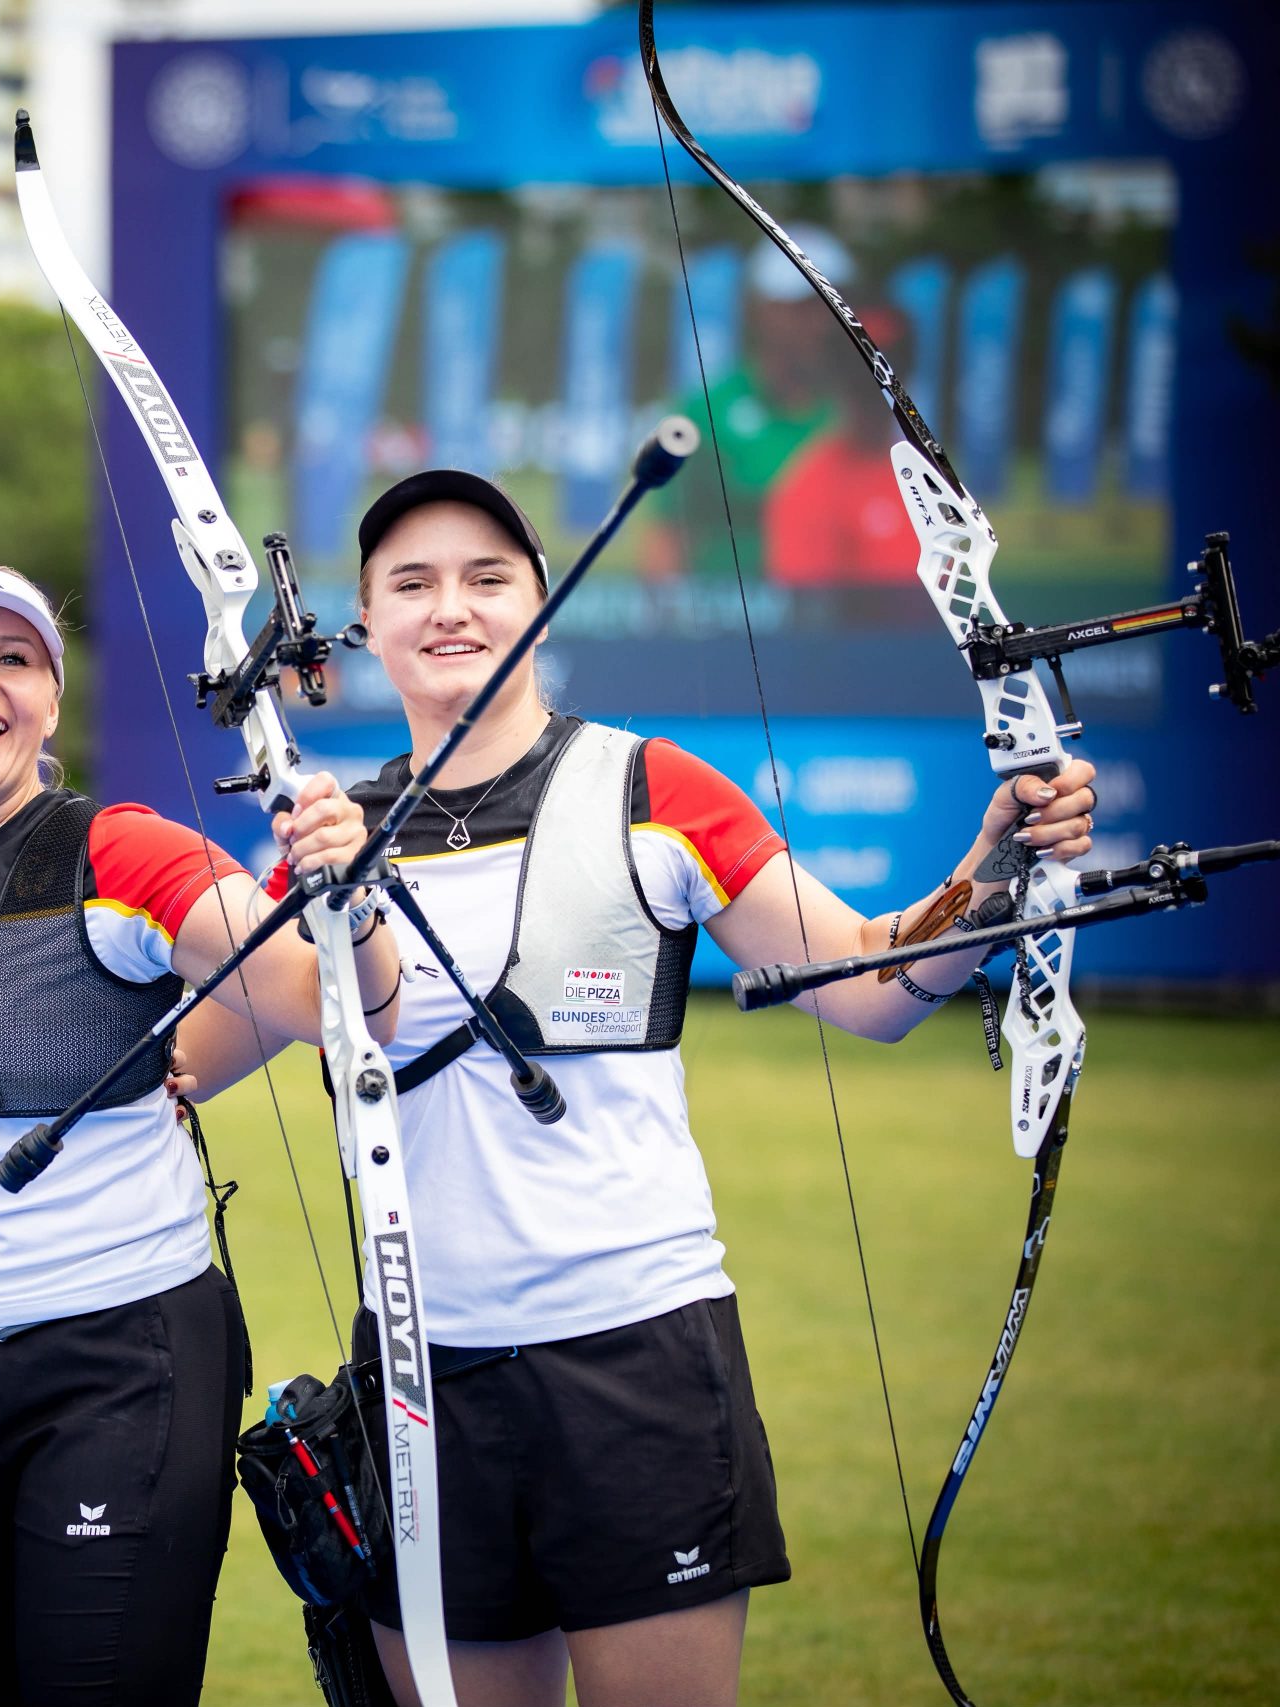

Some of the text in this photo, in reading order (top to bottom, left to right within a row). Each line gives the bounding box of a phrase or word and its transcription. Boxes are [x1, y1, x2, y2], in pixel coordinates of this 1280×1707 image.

[83, 295, 136, 352] METRIX
[123, 371, 191, 457] HOYT
[1068, 626, 1109, 640] AXCEL
[1013, 746, 1050, 759] WIAWIS
[552, 1010, 642, 1023] BUNDESPOLIZEI
[984, 1018, 997, 1051] BEITER
[380, 1241, 420, 1387] HOYT
[394, 1423, 417, 1546] METRIX
[66, 1522, 110, 1536] erima
[667, 1563, 710, 1584] erima
